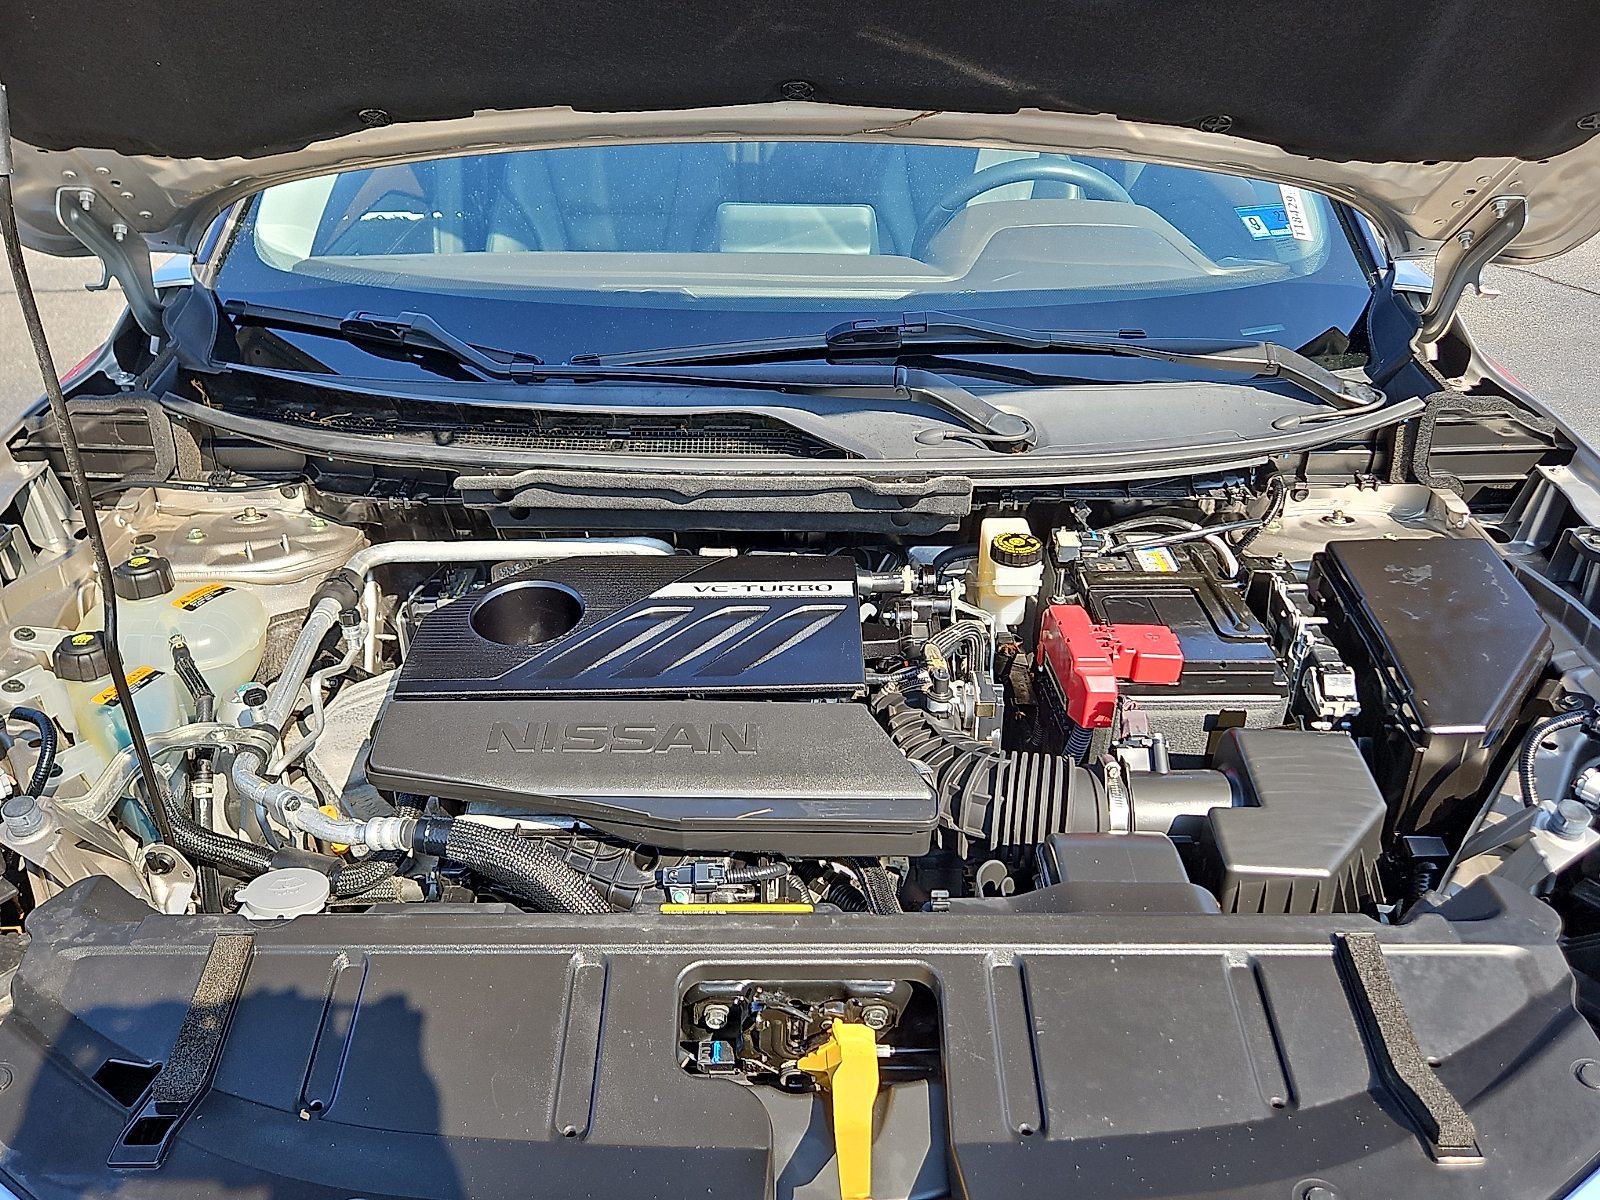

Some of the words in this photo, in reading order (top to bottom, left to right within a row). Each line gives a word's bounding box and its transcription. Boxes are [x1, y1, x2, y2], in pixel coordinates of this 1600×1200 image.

[1248, 217, 1261, 230] 9
[693, 583, 833, 593] VC-TURBO
[486, 722, 758, 754] NISSAN
